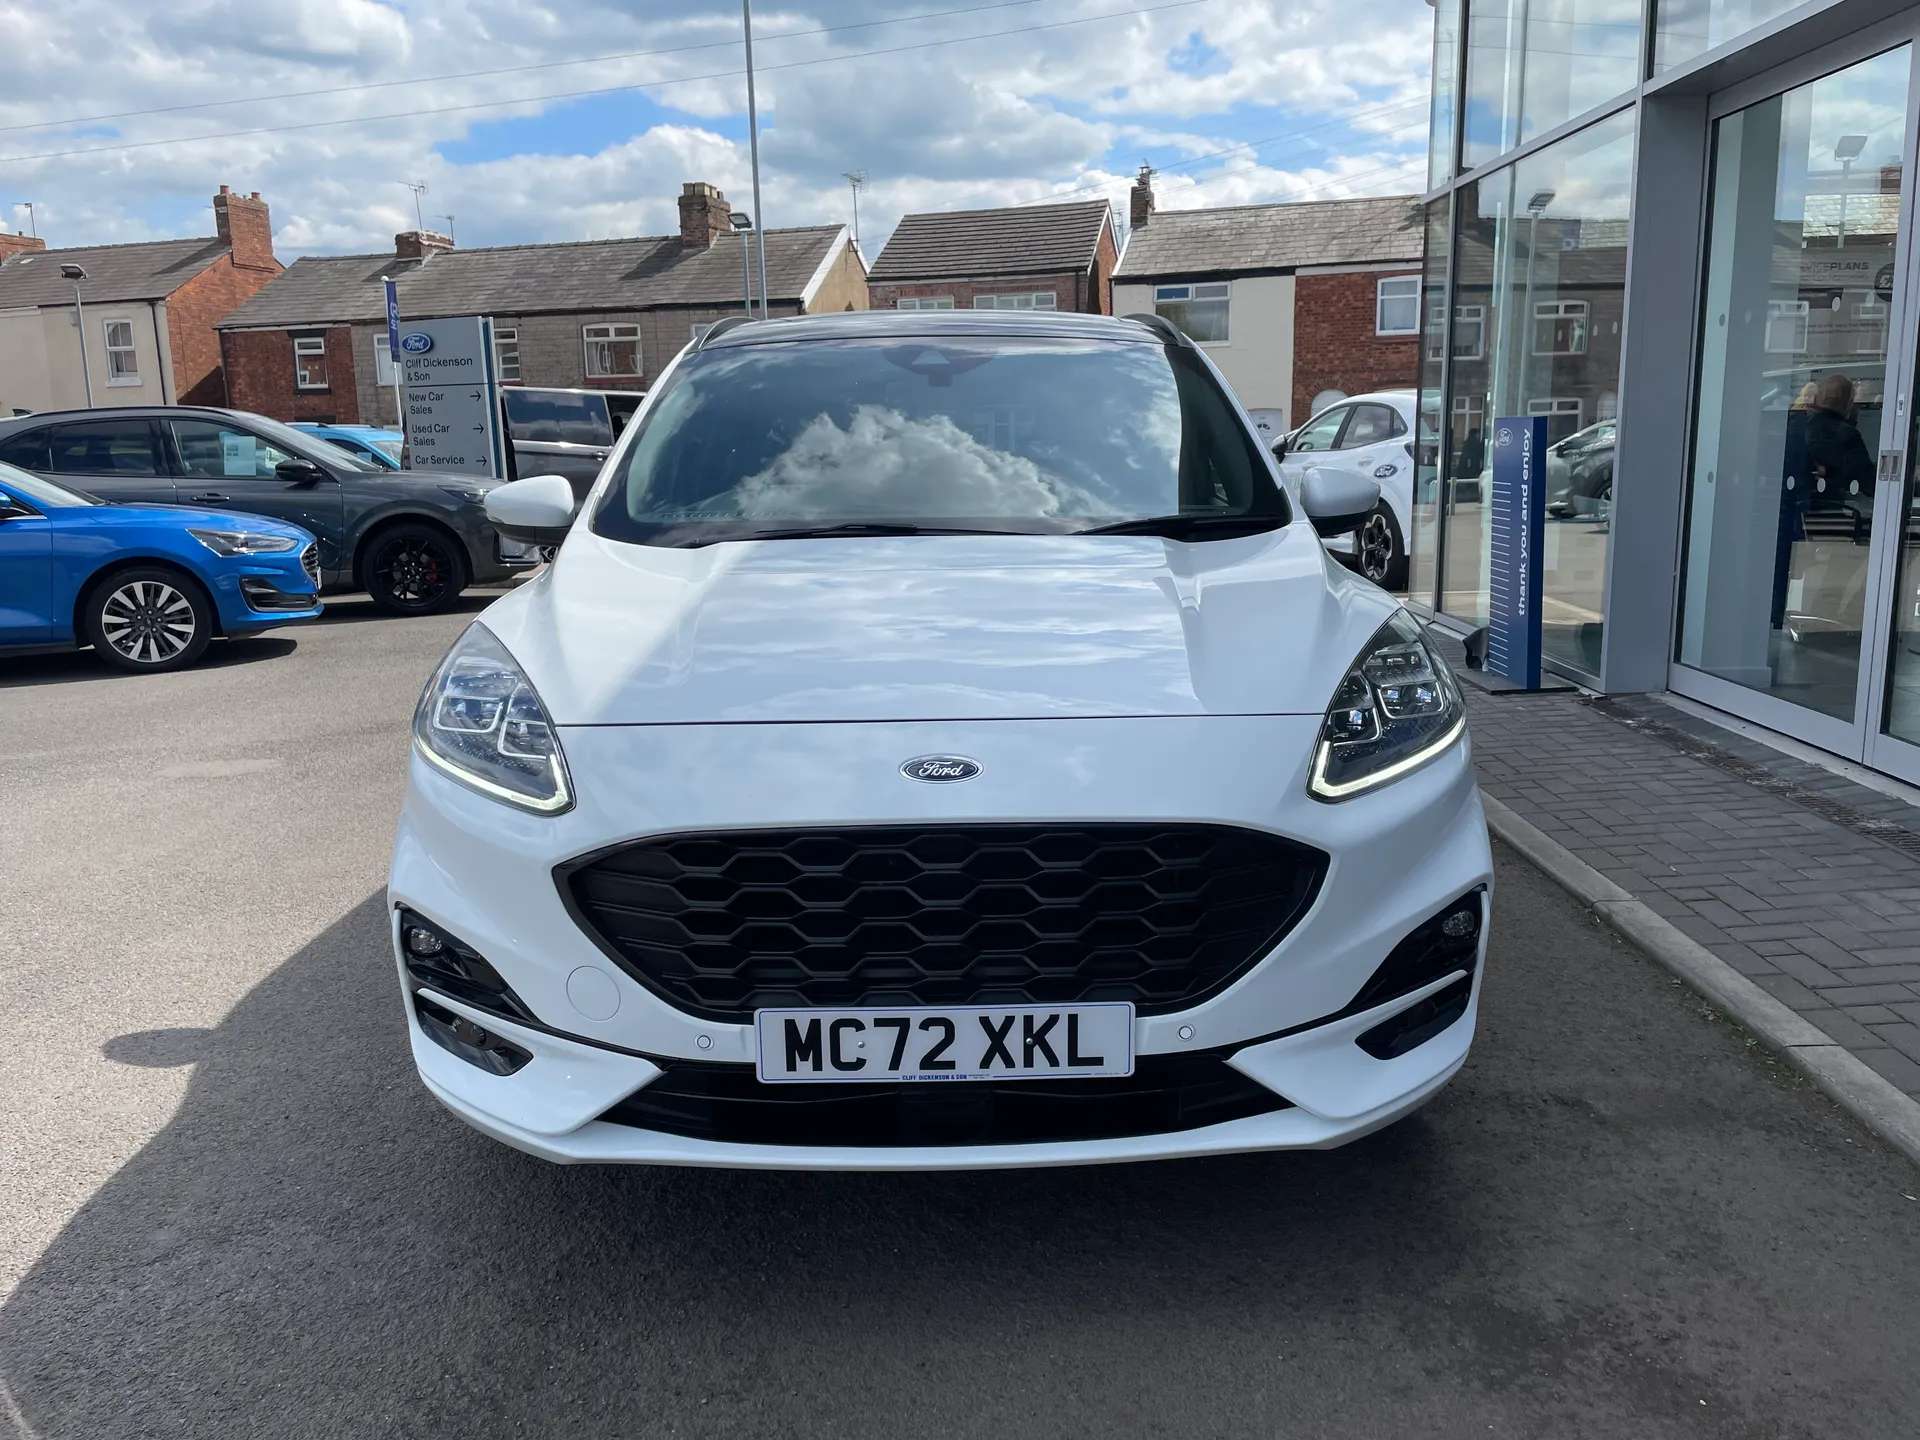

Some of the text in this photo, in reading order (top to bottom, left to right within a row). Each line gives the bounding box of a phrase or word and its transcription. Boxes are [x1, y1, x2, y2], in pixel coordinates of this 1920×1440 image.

[406, 357, 473, 369] Cliff Dickenson
[408, 371, 431, 381] & Son
[409, 391, 445, 402] New Car
[410, 405, 433, 415] Sales
[412, 423, 450, 434] Used Car
[413, 436, 436, 446] Sales
[415, 455, 465, 465] Car Service
[1518, 428, 1531, 616] thank you and enjoy
[918, 760, 964, 777] Ford
[784, 1013, 1105, 1072] MC72 XKL
